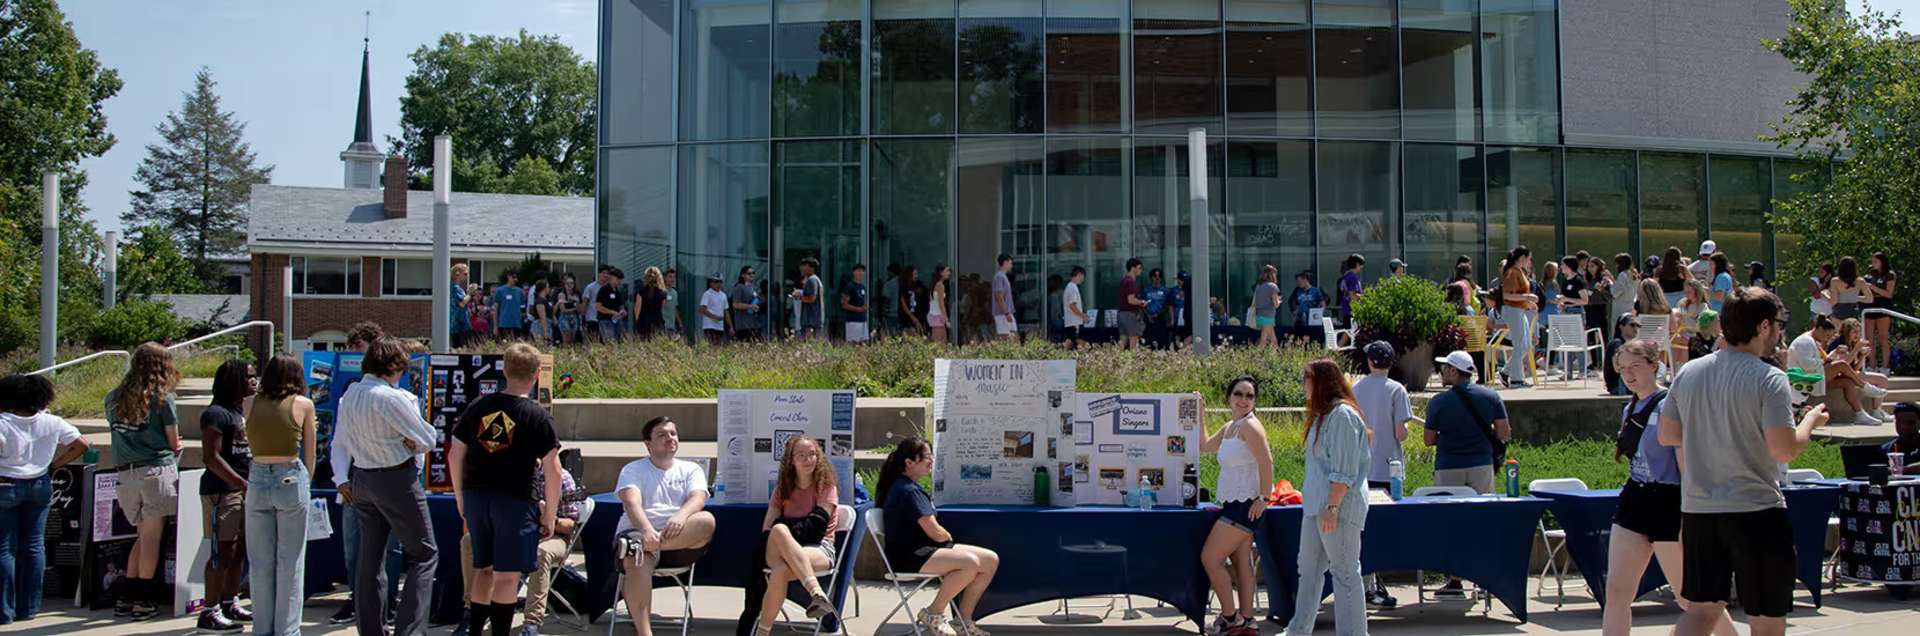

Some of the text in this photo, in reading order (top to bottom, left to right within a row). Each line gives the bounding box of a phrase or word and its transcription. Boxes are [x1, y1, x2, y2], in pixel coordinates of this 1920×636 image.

[965, 364, 1023, 381] WOMEN IN
[1508, 468, 1517, 478] G
[1892, 552, 1911, 566] FOR
